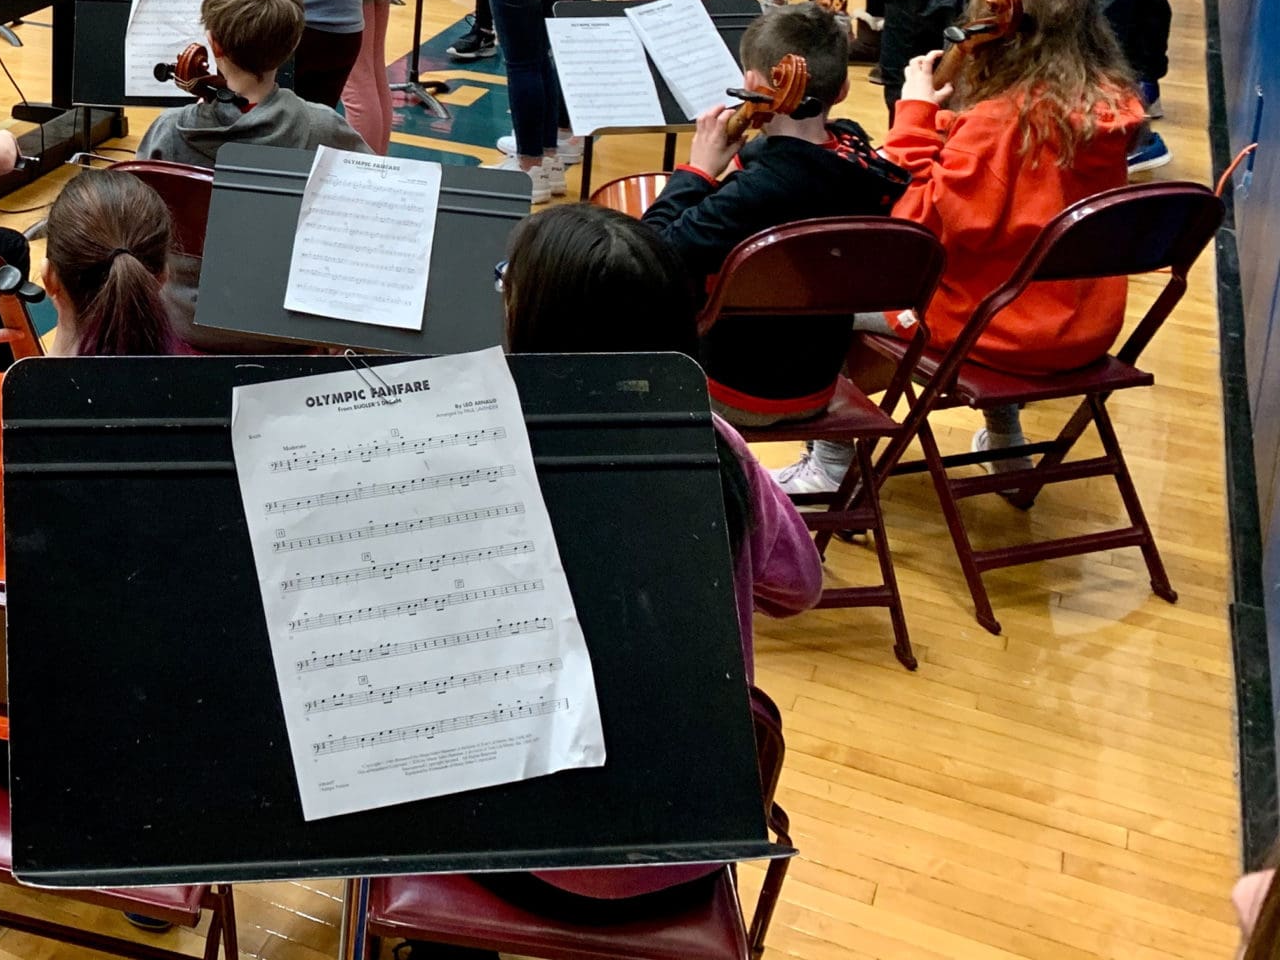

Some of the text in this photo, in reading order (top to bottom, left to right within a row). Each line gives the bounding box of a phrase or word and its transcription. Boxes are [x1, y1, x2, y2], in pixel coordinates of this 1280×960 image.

[305, 379, 431, 408] OLYMPIC FANFARE
[354, 401, 380, 410] BUGLER'S
